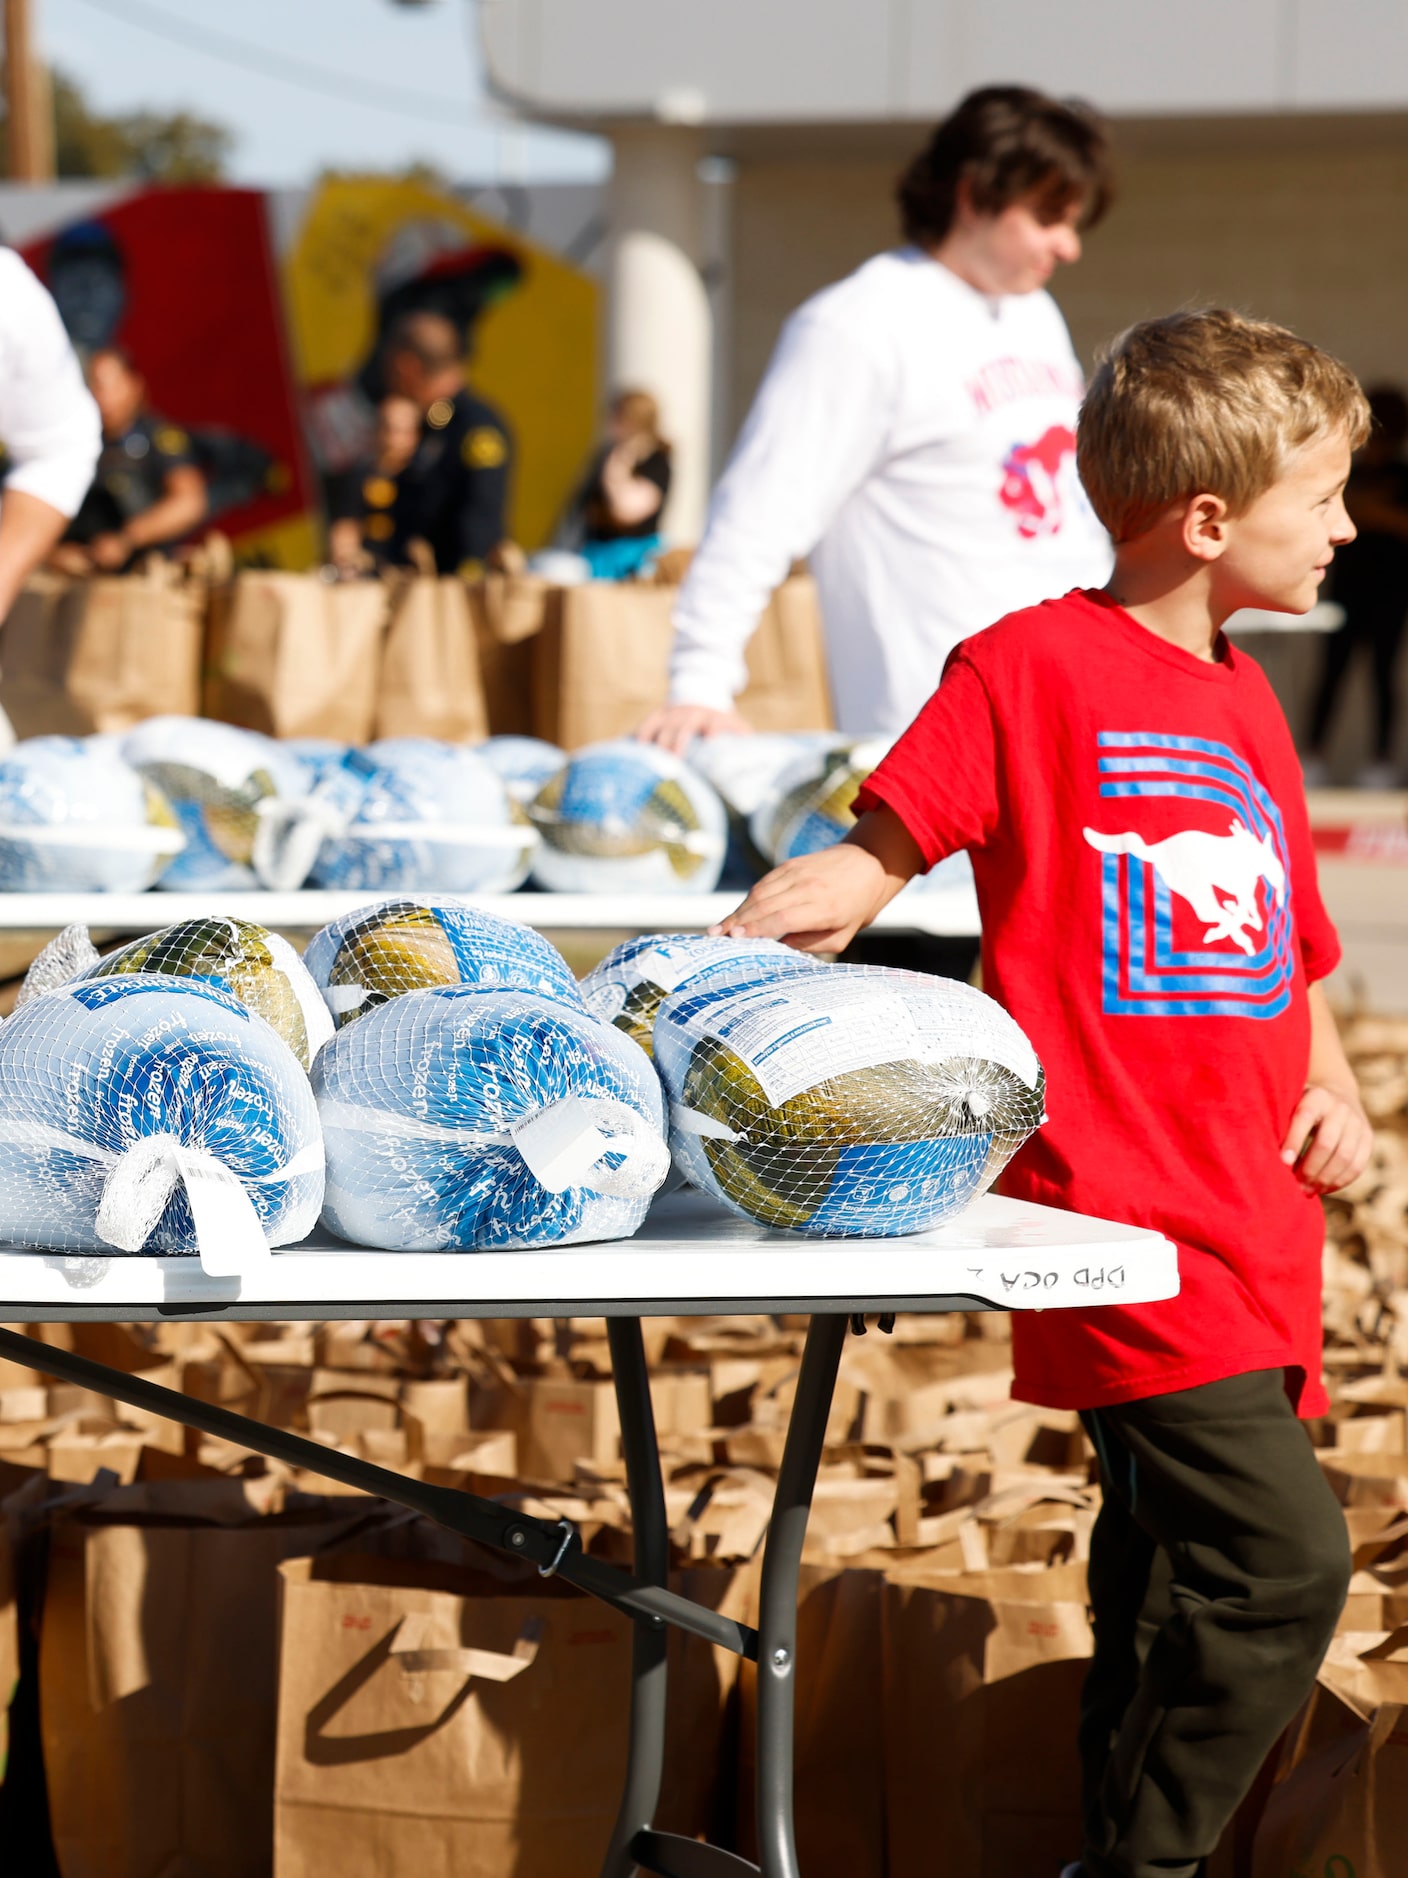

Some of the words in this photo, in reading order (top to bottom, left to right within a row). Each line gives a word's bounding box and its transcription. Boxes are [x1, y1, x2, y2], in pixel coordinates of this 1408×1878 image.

[138, 1010, 187, 1049] frozen
[188, 1031, 242, 1048] frozen
[99, 1026, 131, 1079] frozen
[412, 1042, 442, 1117] frozen
[447, 1062, 460, 1102] frozen
[229, 1080, 273, 1121] frozen
[377, 1137, 440, 1206] frozen
[1073, 1265, 1125, 1289] DPD
